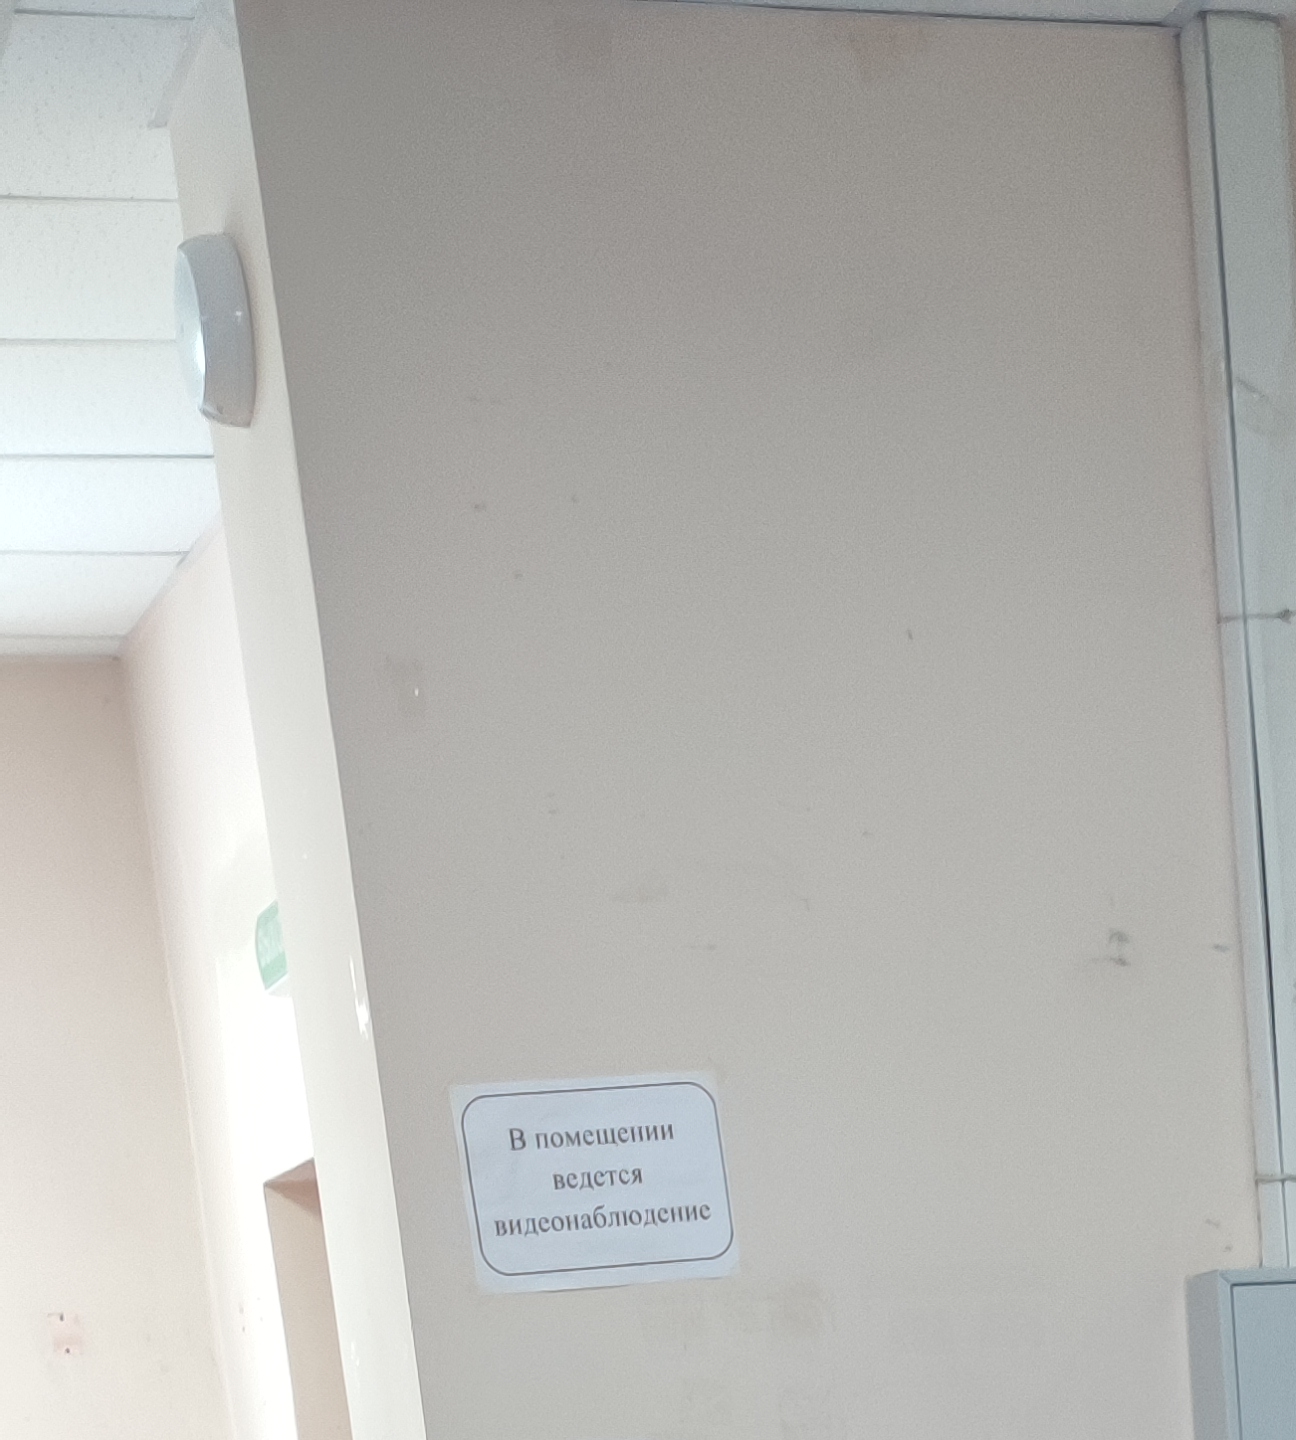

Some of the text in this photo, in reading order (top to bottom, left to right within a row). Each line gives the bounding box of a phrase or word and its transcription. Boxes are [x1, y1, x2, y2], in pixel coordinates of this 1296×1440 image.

[509, 1123, 674, 1151] В помещении
[553, 1167, 643, 1190] ведется
[494, 1203, 712, 1237] видеонаблюдение
